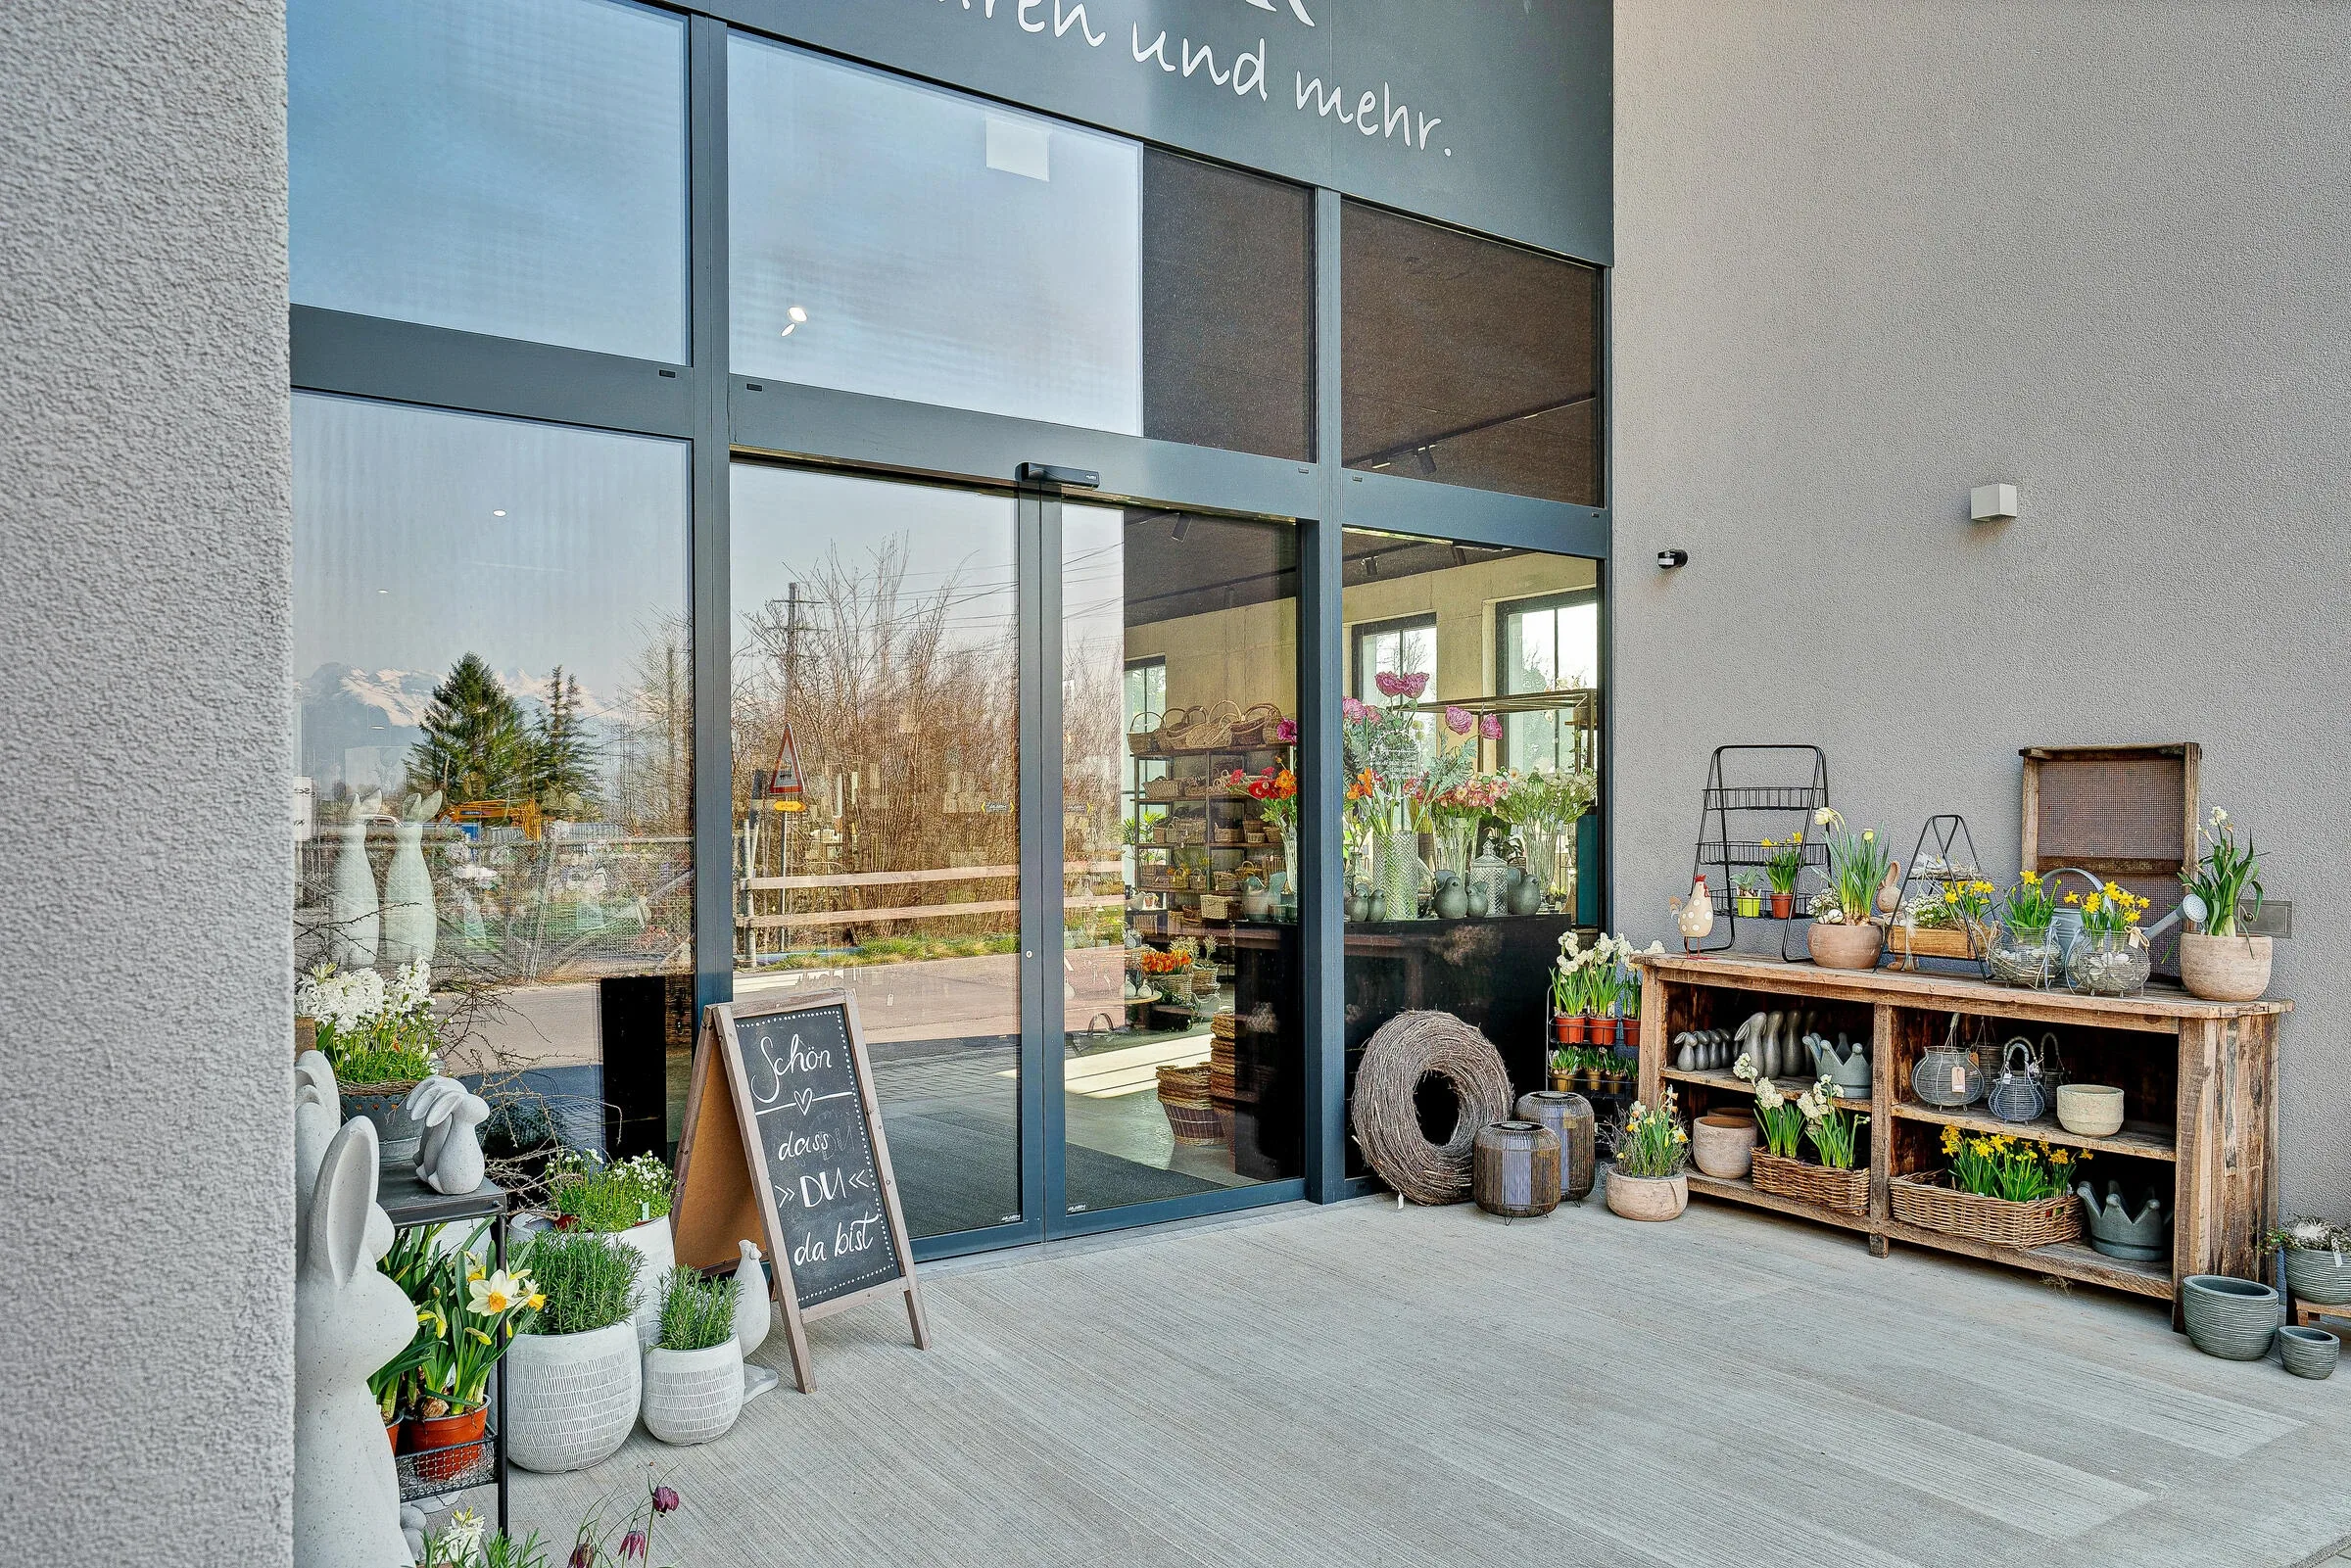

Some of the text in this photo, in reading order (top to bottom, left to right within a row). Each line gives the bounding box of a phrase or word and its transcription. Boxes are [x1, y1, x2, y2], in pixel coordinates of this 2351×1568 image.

[1131, 20, 1268, 102] und
[1295, 70, 1453, 157] mehr.
[750, 1032, 833, 1104] Schön
[778, 1130, 830, 1162] dass
[793, 1211, 881, 1266] da bist
